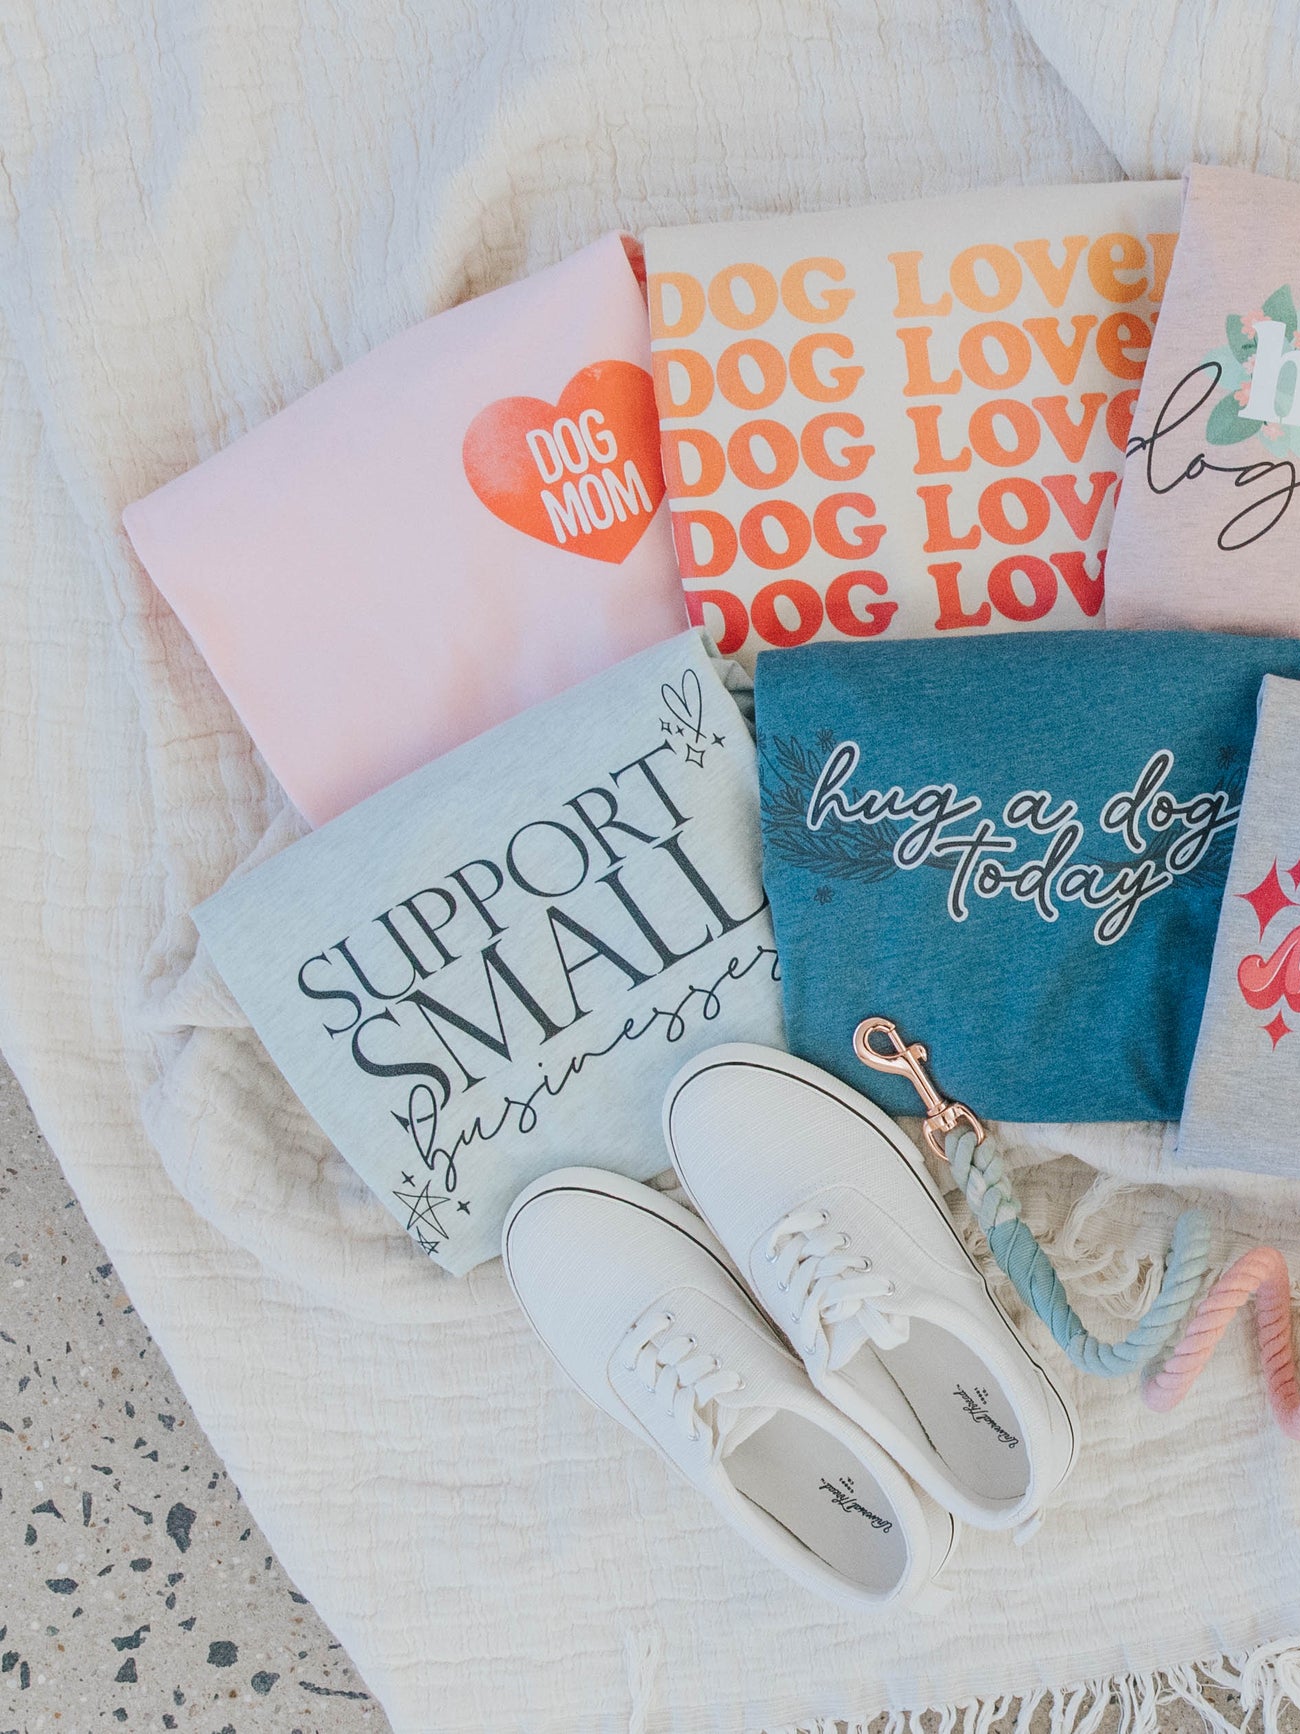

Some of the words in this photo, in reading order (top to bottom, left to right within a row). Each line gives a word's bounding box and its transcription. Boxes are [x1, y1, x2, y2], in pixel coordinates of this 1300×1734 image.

[650, 257, 855, 339] DOG
[652, 332, 865, 418] DOG
[524, 408, 618, 484] DOG
[660, 412, 876, 498] DOG
[539, 460, 654, 545] MOM
[672, 492, 887, 578] DOG
[685, 569, 899, 655] DOG
[807, 740, 981, 870] hug
[1003, 789, 1074, 836] a
[1101, 749, 1241, 872] dog
[298, 740, 694, 1039] SUPPORT
[352, 830, 769, 1131] SMALL
[976, 1413, 1019, 1449] Universal
[846, 1501, 893, 1533] Universal
